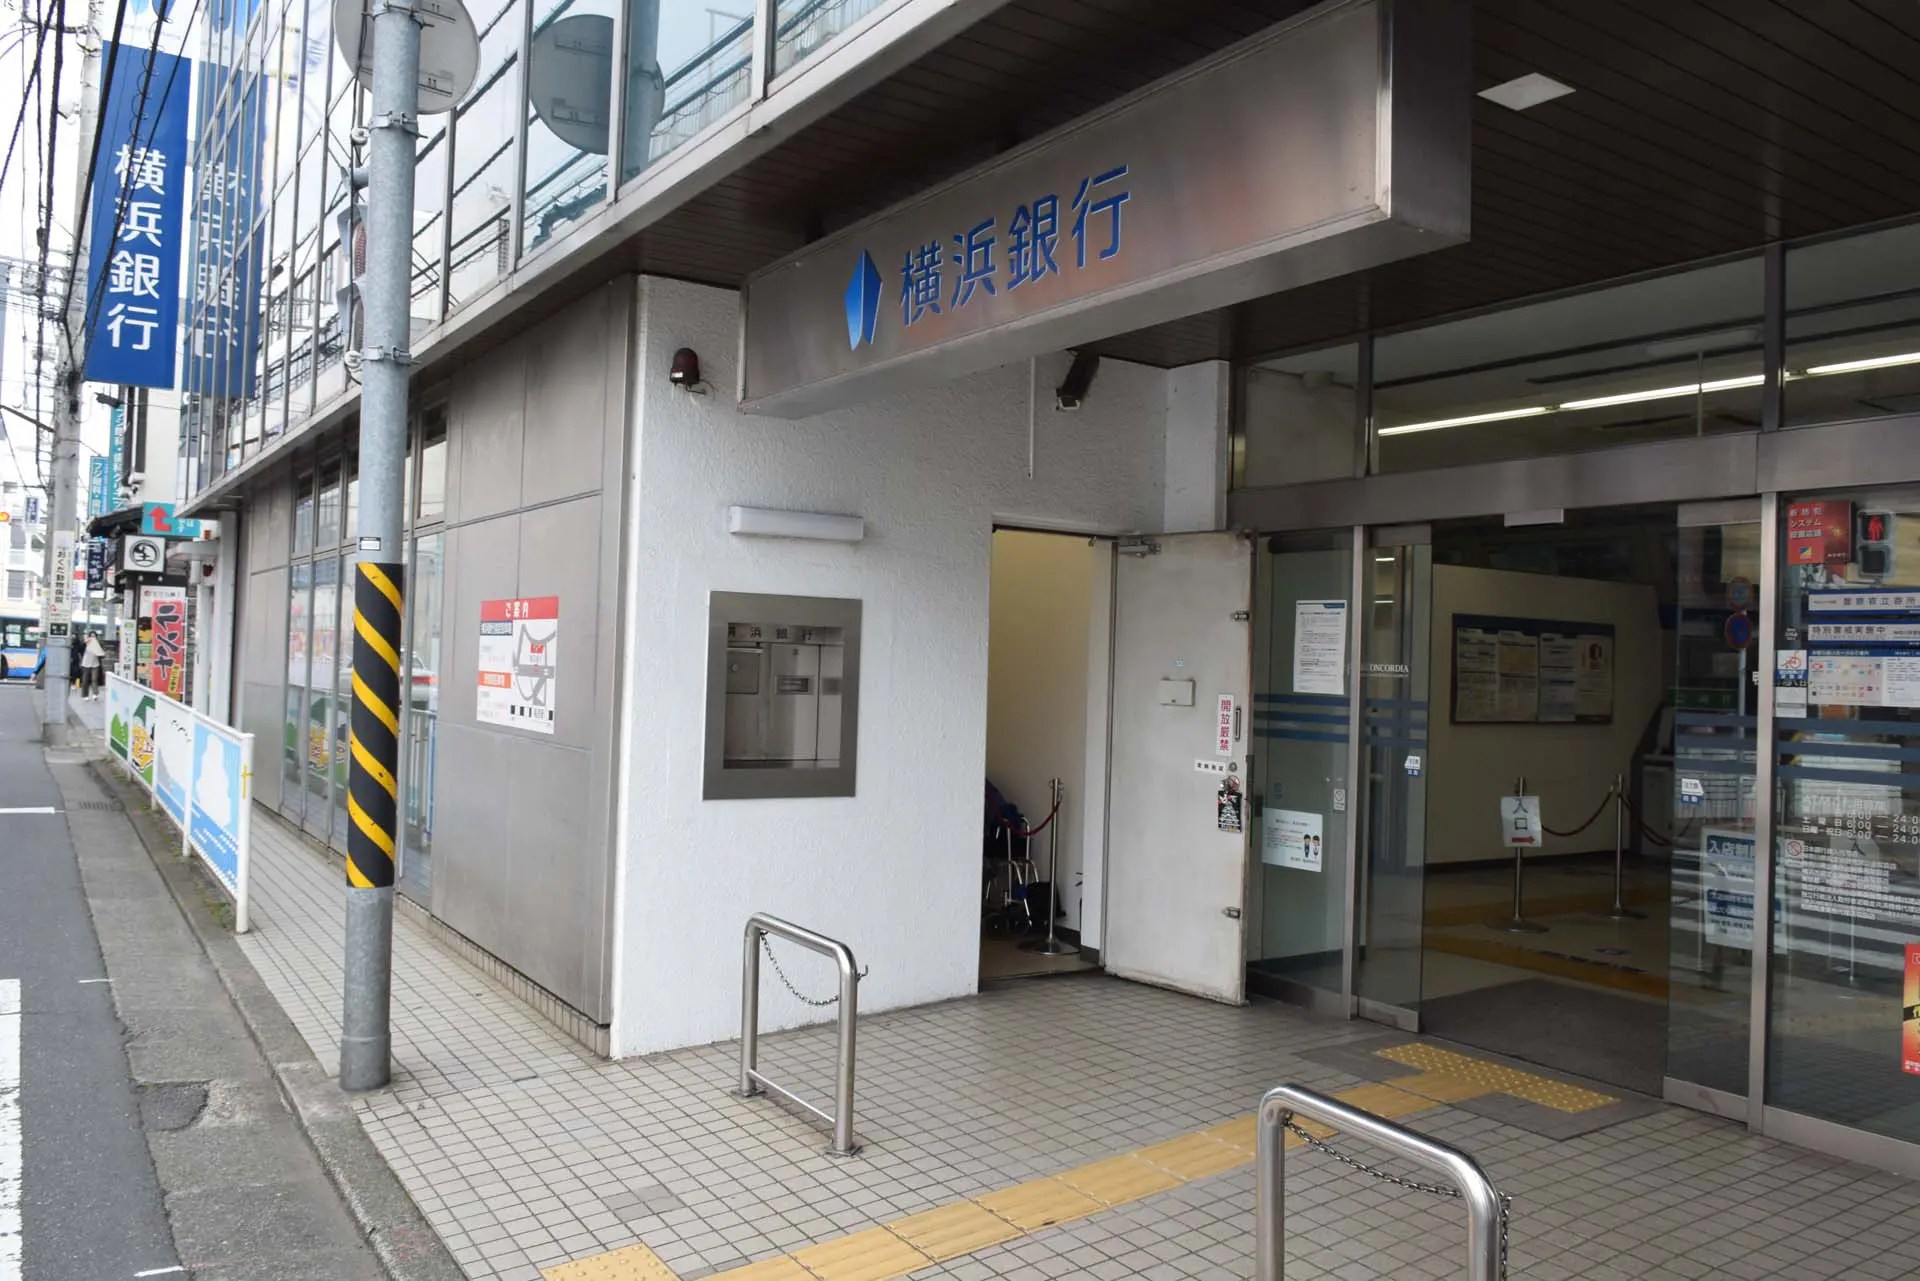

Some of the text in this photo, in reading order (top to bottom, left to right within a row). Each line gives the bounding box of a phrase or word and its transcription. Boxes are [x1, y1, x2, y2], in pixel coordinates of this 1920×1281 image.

[107, 144, 168, 351] 横浜銀行
[900, 164, 1131, 327] 横浜銀行
[1512, 799, 1529, 831] 入口
[1892, 815, 1920, 825] 24:0
[1847, 820, 1872, 830] 6:00
[1892, 825, 1920, 834] 24:0
[1892, 834, 1920, 844] 24:0
[1708, 840, 1755, 858] 入店制
